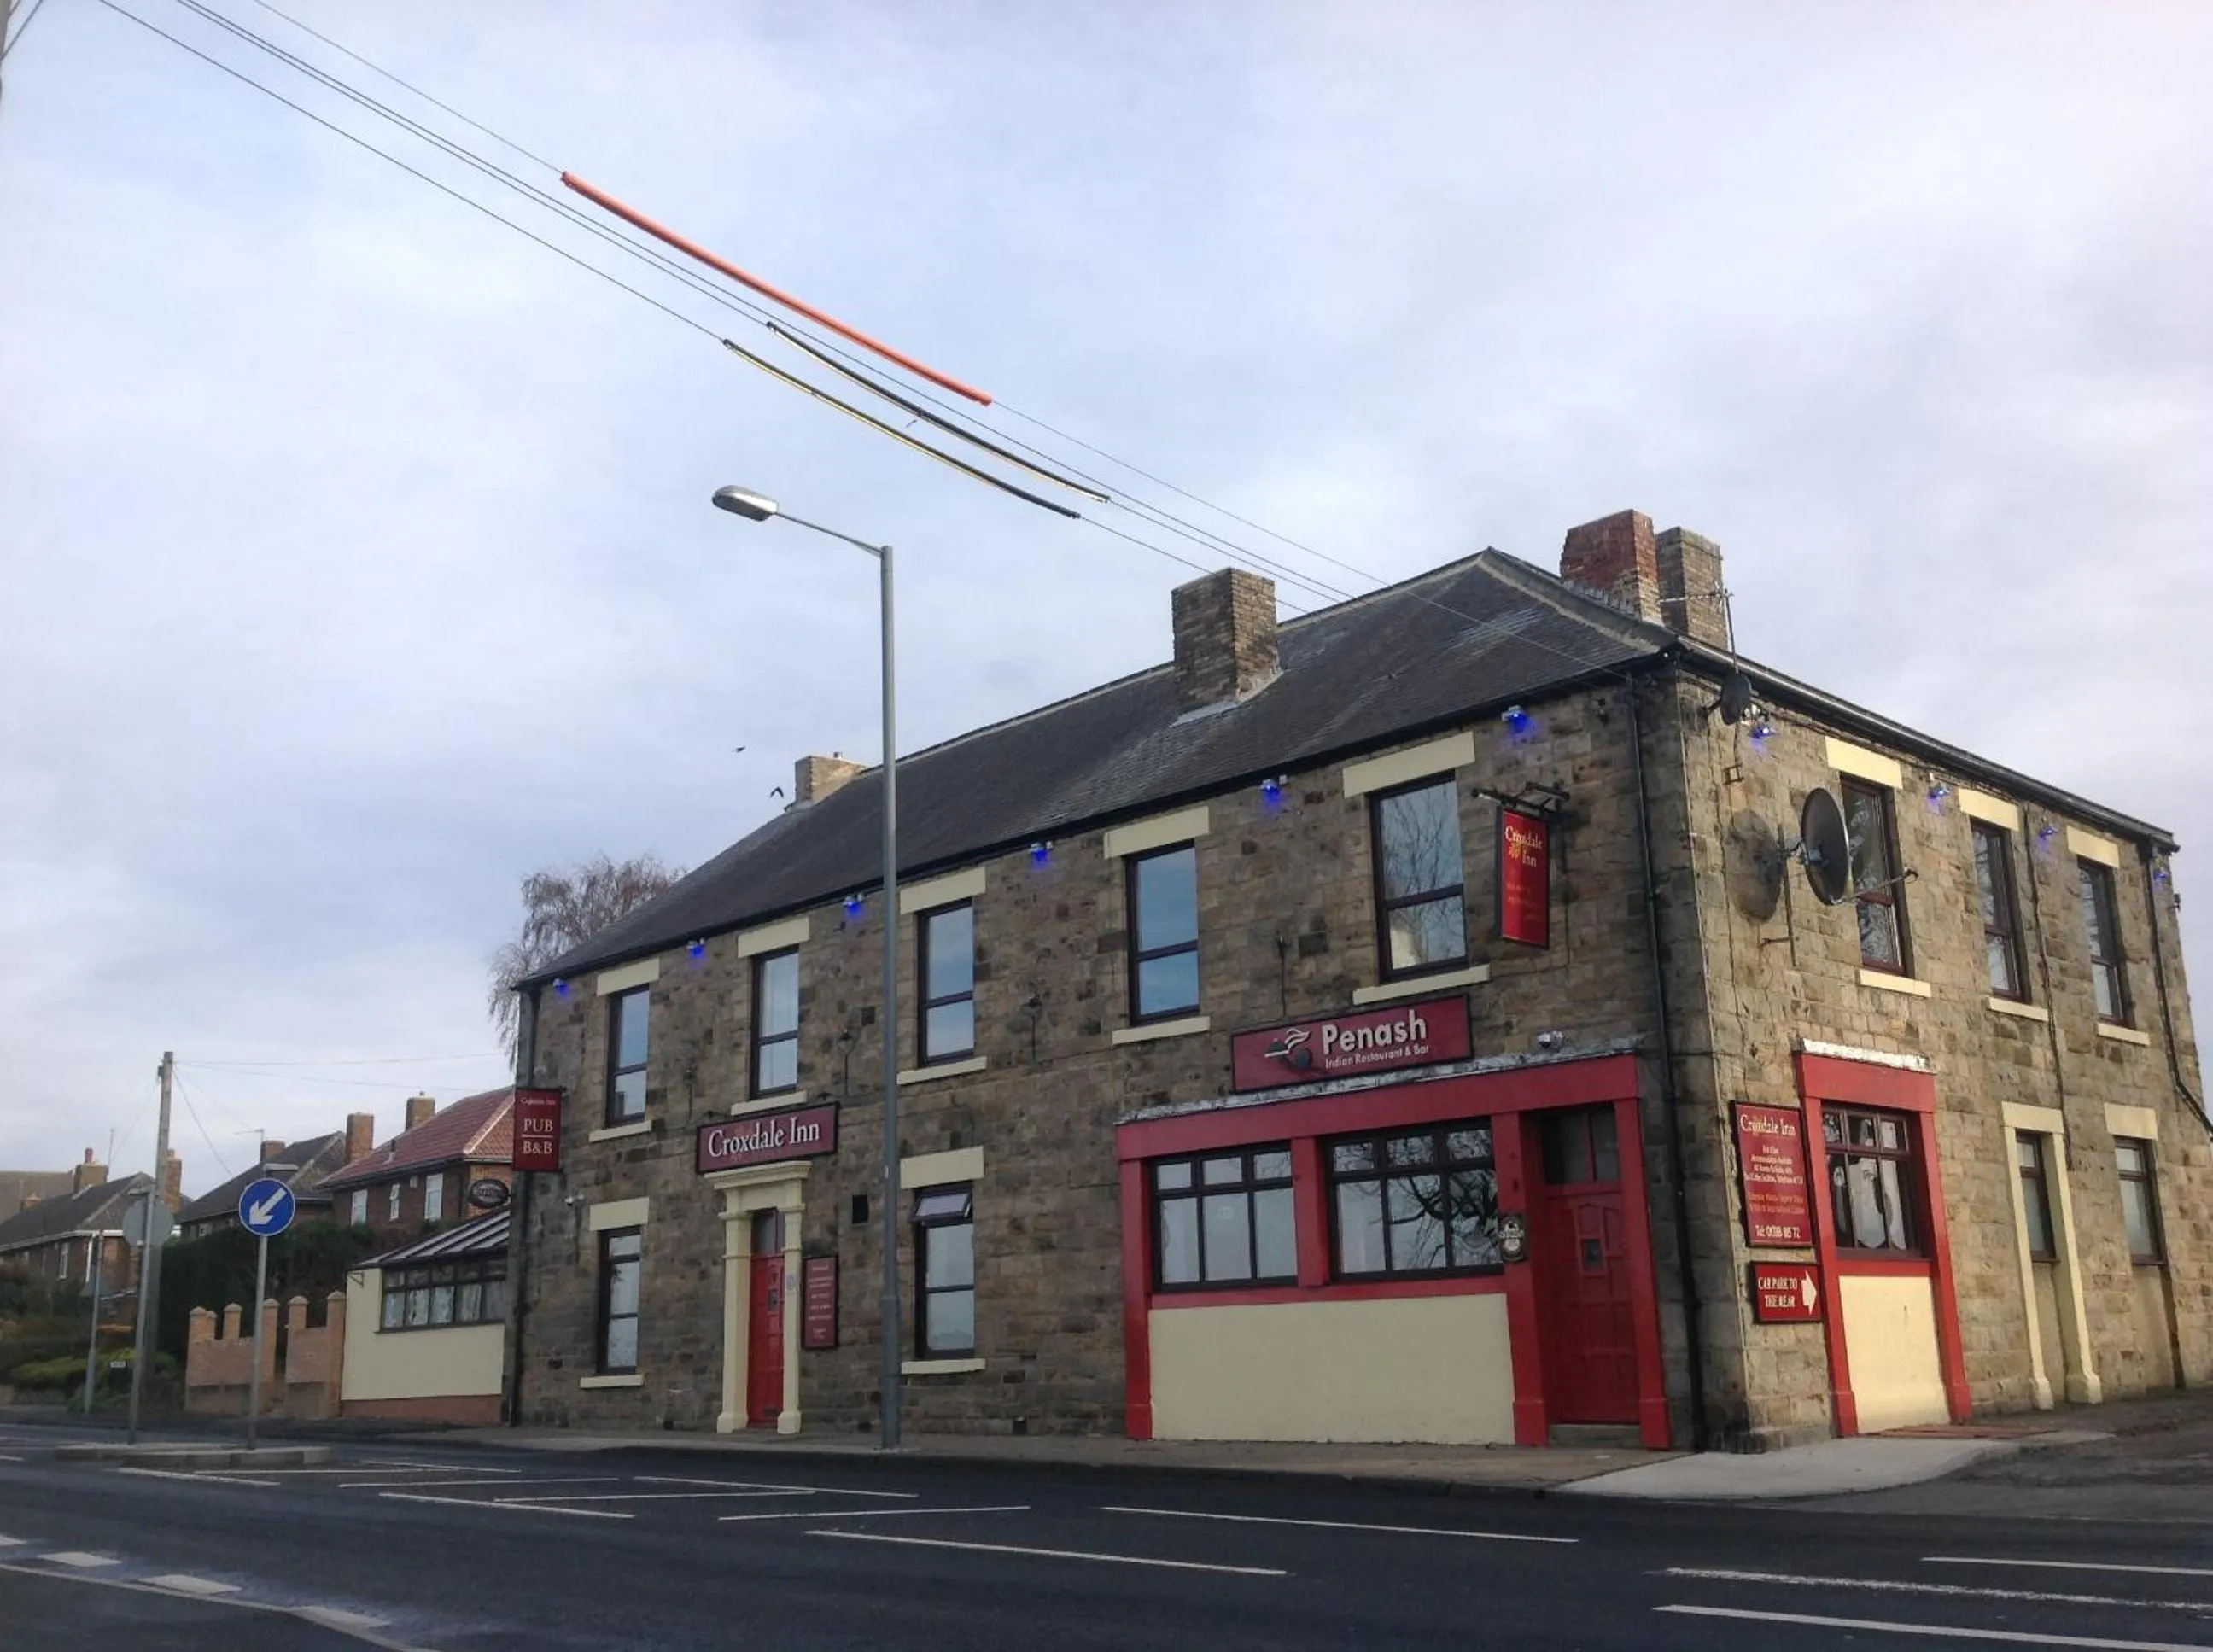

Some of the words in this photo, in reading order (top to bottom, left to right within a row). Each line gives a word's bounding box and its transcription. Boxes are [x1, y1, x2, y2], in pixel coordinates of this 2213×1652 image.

[1323, 1009, 1427, 1055] Penash
[1325, 1056, 1353, 1069] Indian
[1355, 1048, 1403, 1065] Restaurant
[1404, 1046, 1411, 1056] &
[1413, 1043, 1429, 1055] Bar
[523, 1118, 553, 1133] PUB
[708, 1120, 785, 1158] Croxdale
[788, 1115, 820, 1144] Inn
[523, 1141, 552, 1154] B&B
[1758, 1277, 1771, 1289] CAR
[1772, 1277, 1789, 1289] PARK
[1790, 1278, 1797, 1290] TO
[1764, 1294, 1778, 1307] THE
[1778, 1295, 1796, 1307] REAR
